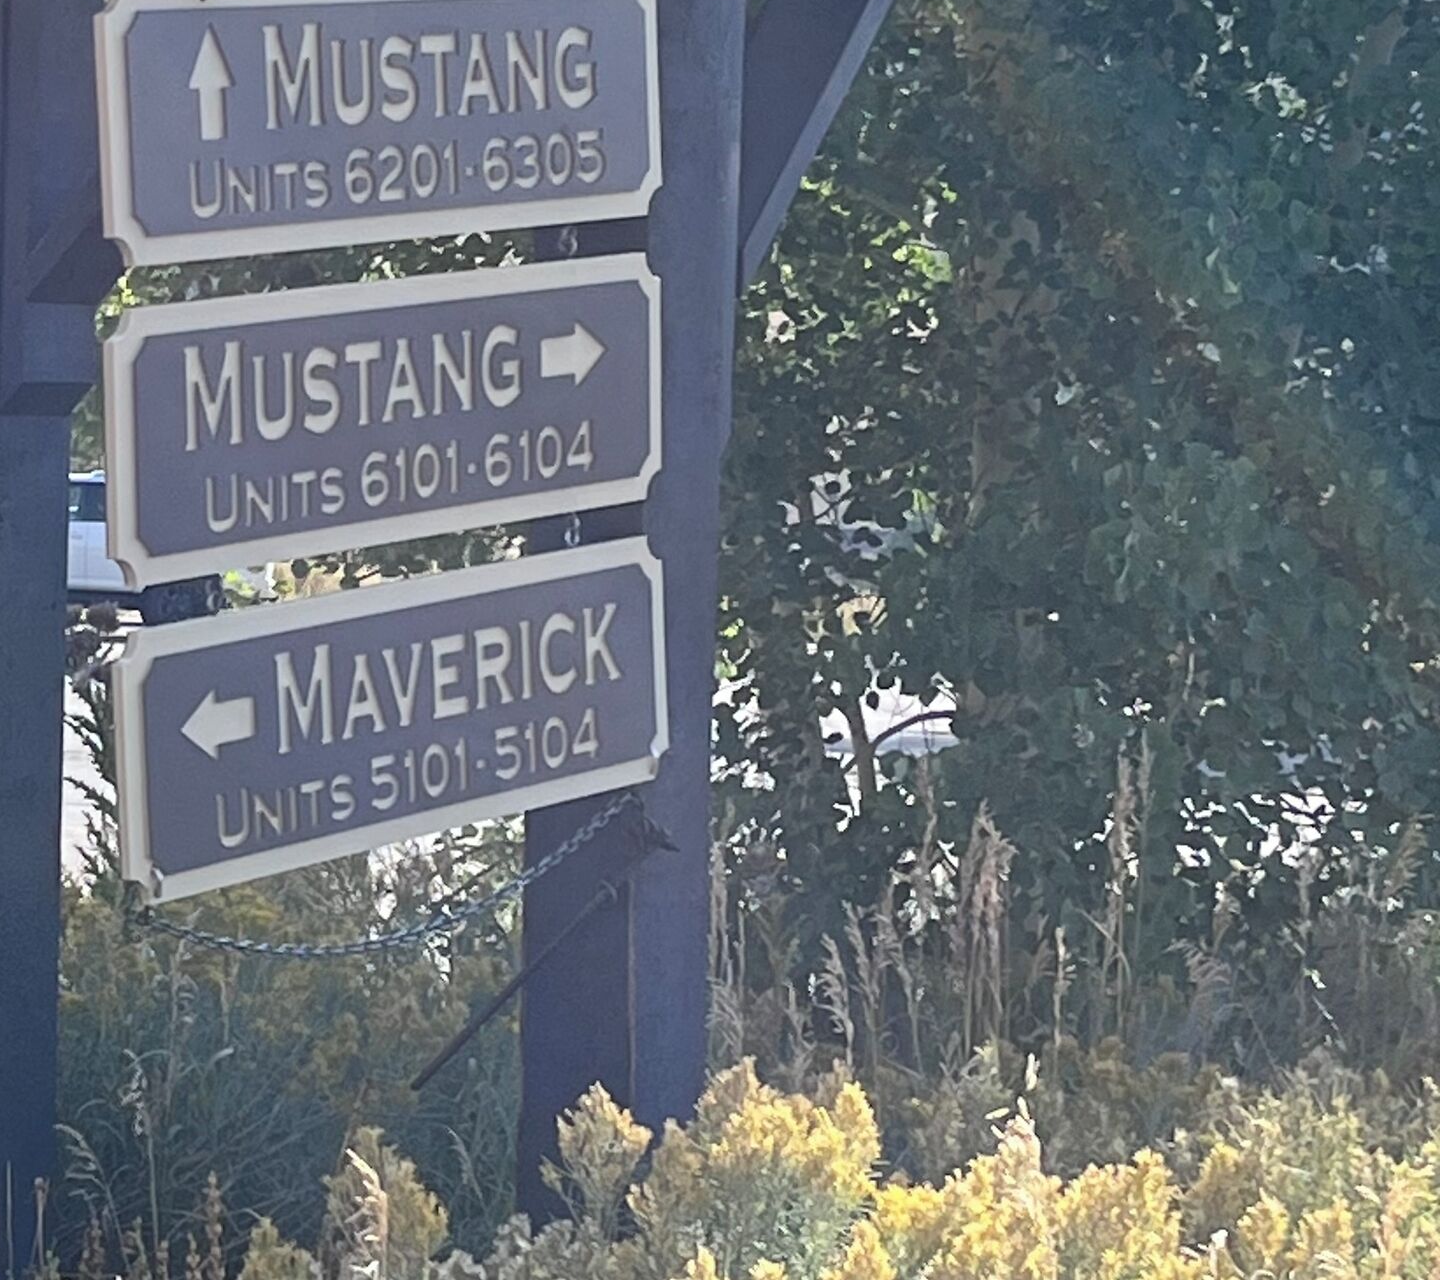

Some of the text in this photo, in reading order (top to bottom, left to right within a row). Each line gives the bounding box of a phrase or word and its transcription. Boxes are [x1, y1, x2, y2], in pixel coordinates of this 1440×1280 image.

[263, 23, 597, 131] MUSTANG
[189, 158, 330, 219] UNITS
[184, 324, 523, 452] MUSTANG
[205, 467, 346, 533] UNITS
[274, 602, 622, 755] MAVERICK
[215, 774, 357, 849] UNITS
